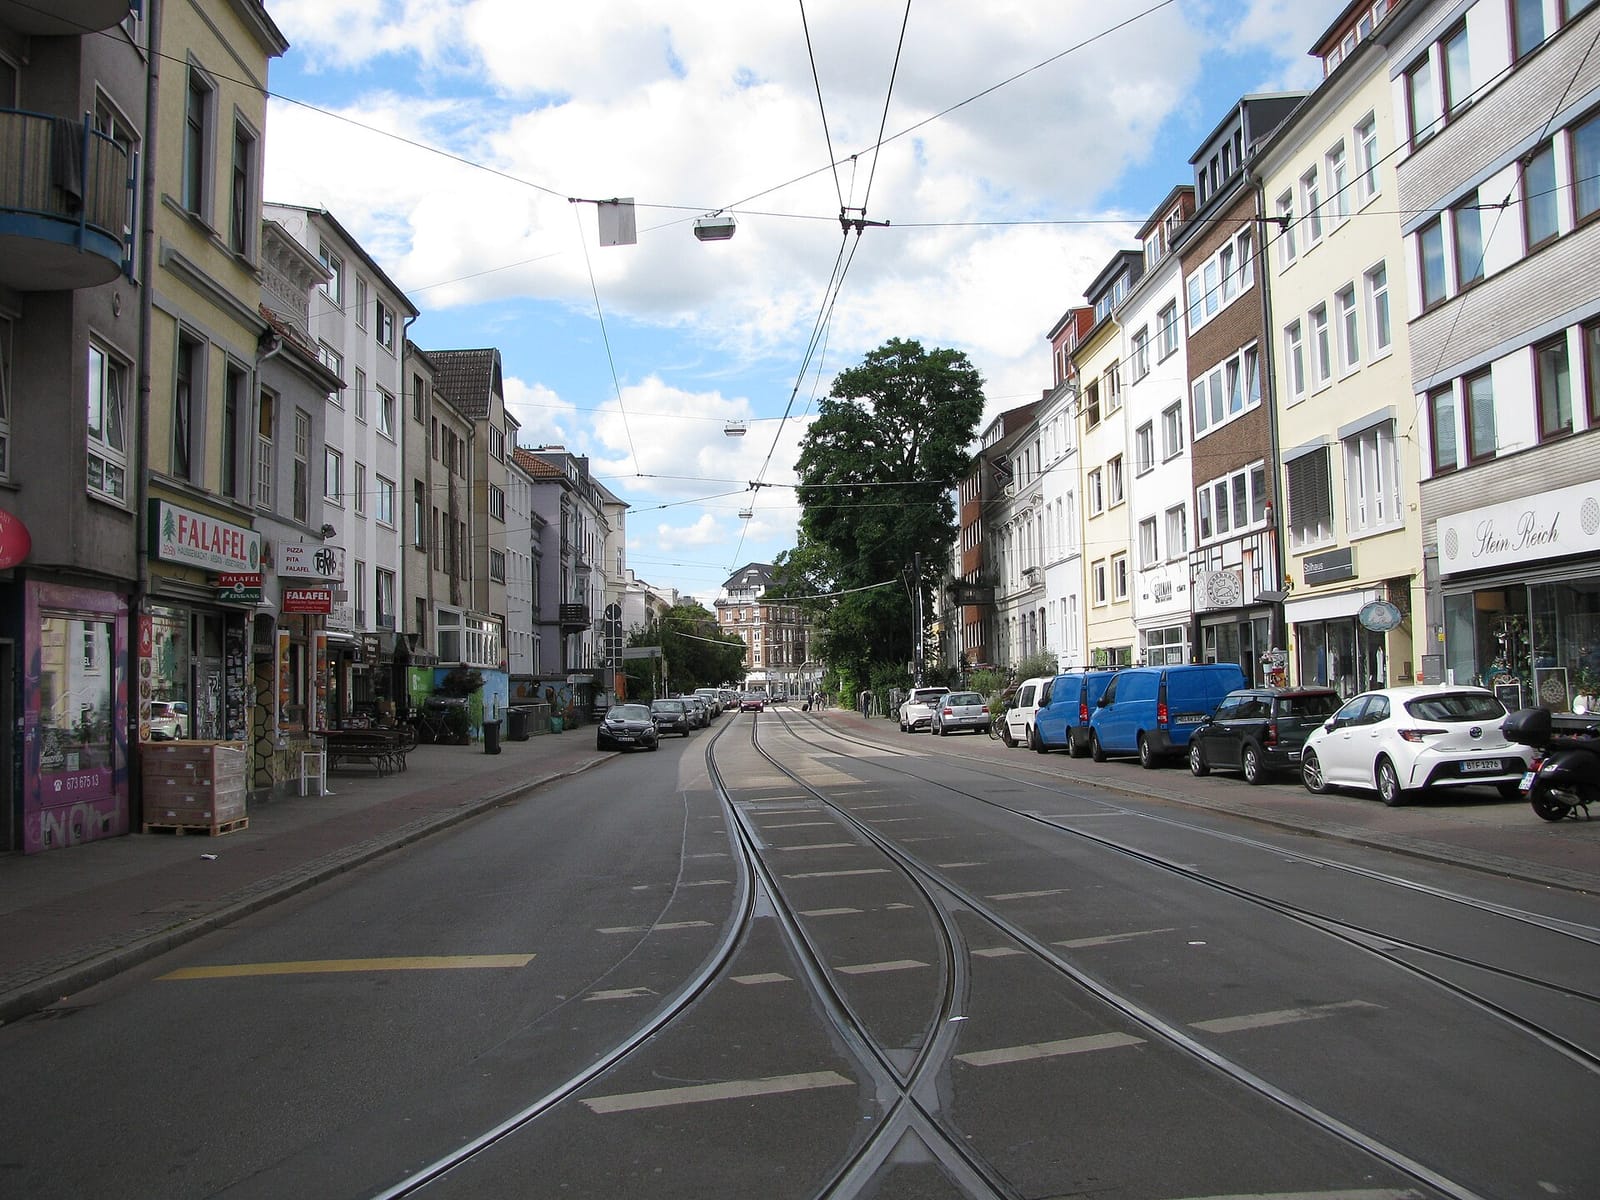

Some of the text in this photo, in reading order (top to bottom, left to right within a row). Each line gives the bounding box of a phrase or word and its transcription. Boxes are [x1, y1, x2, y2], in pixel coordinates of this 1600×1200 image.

[178, 514, 247, 561] FALAFEL
[1472, 510, 1560, 558] Stein Reich
[286, 591, 330, 600] FALAFEL
